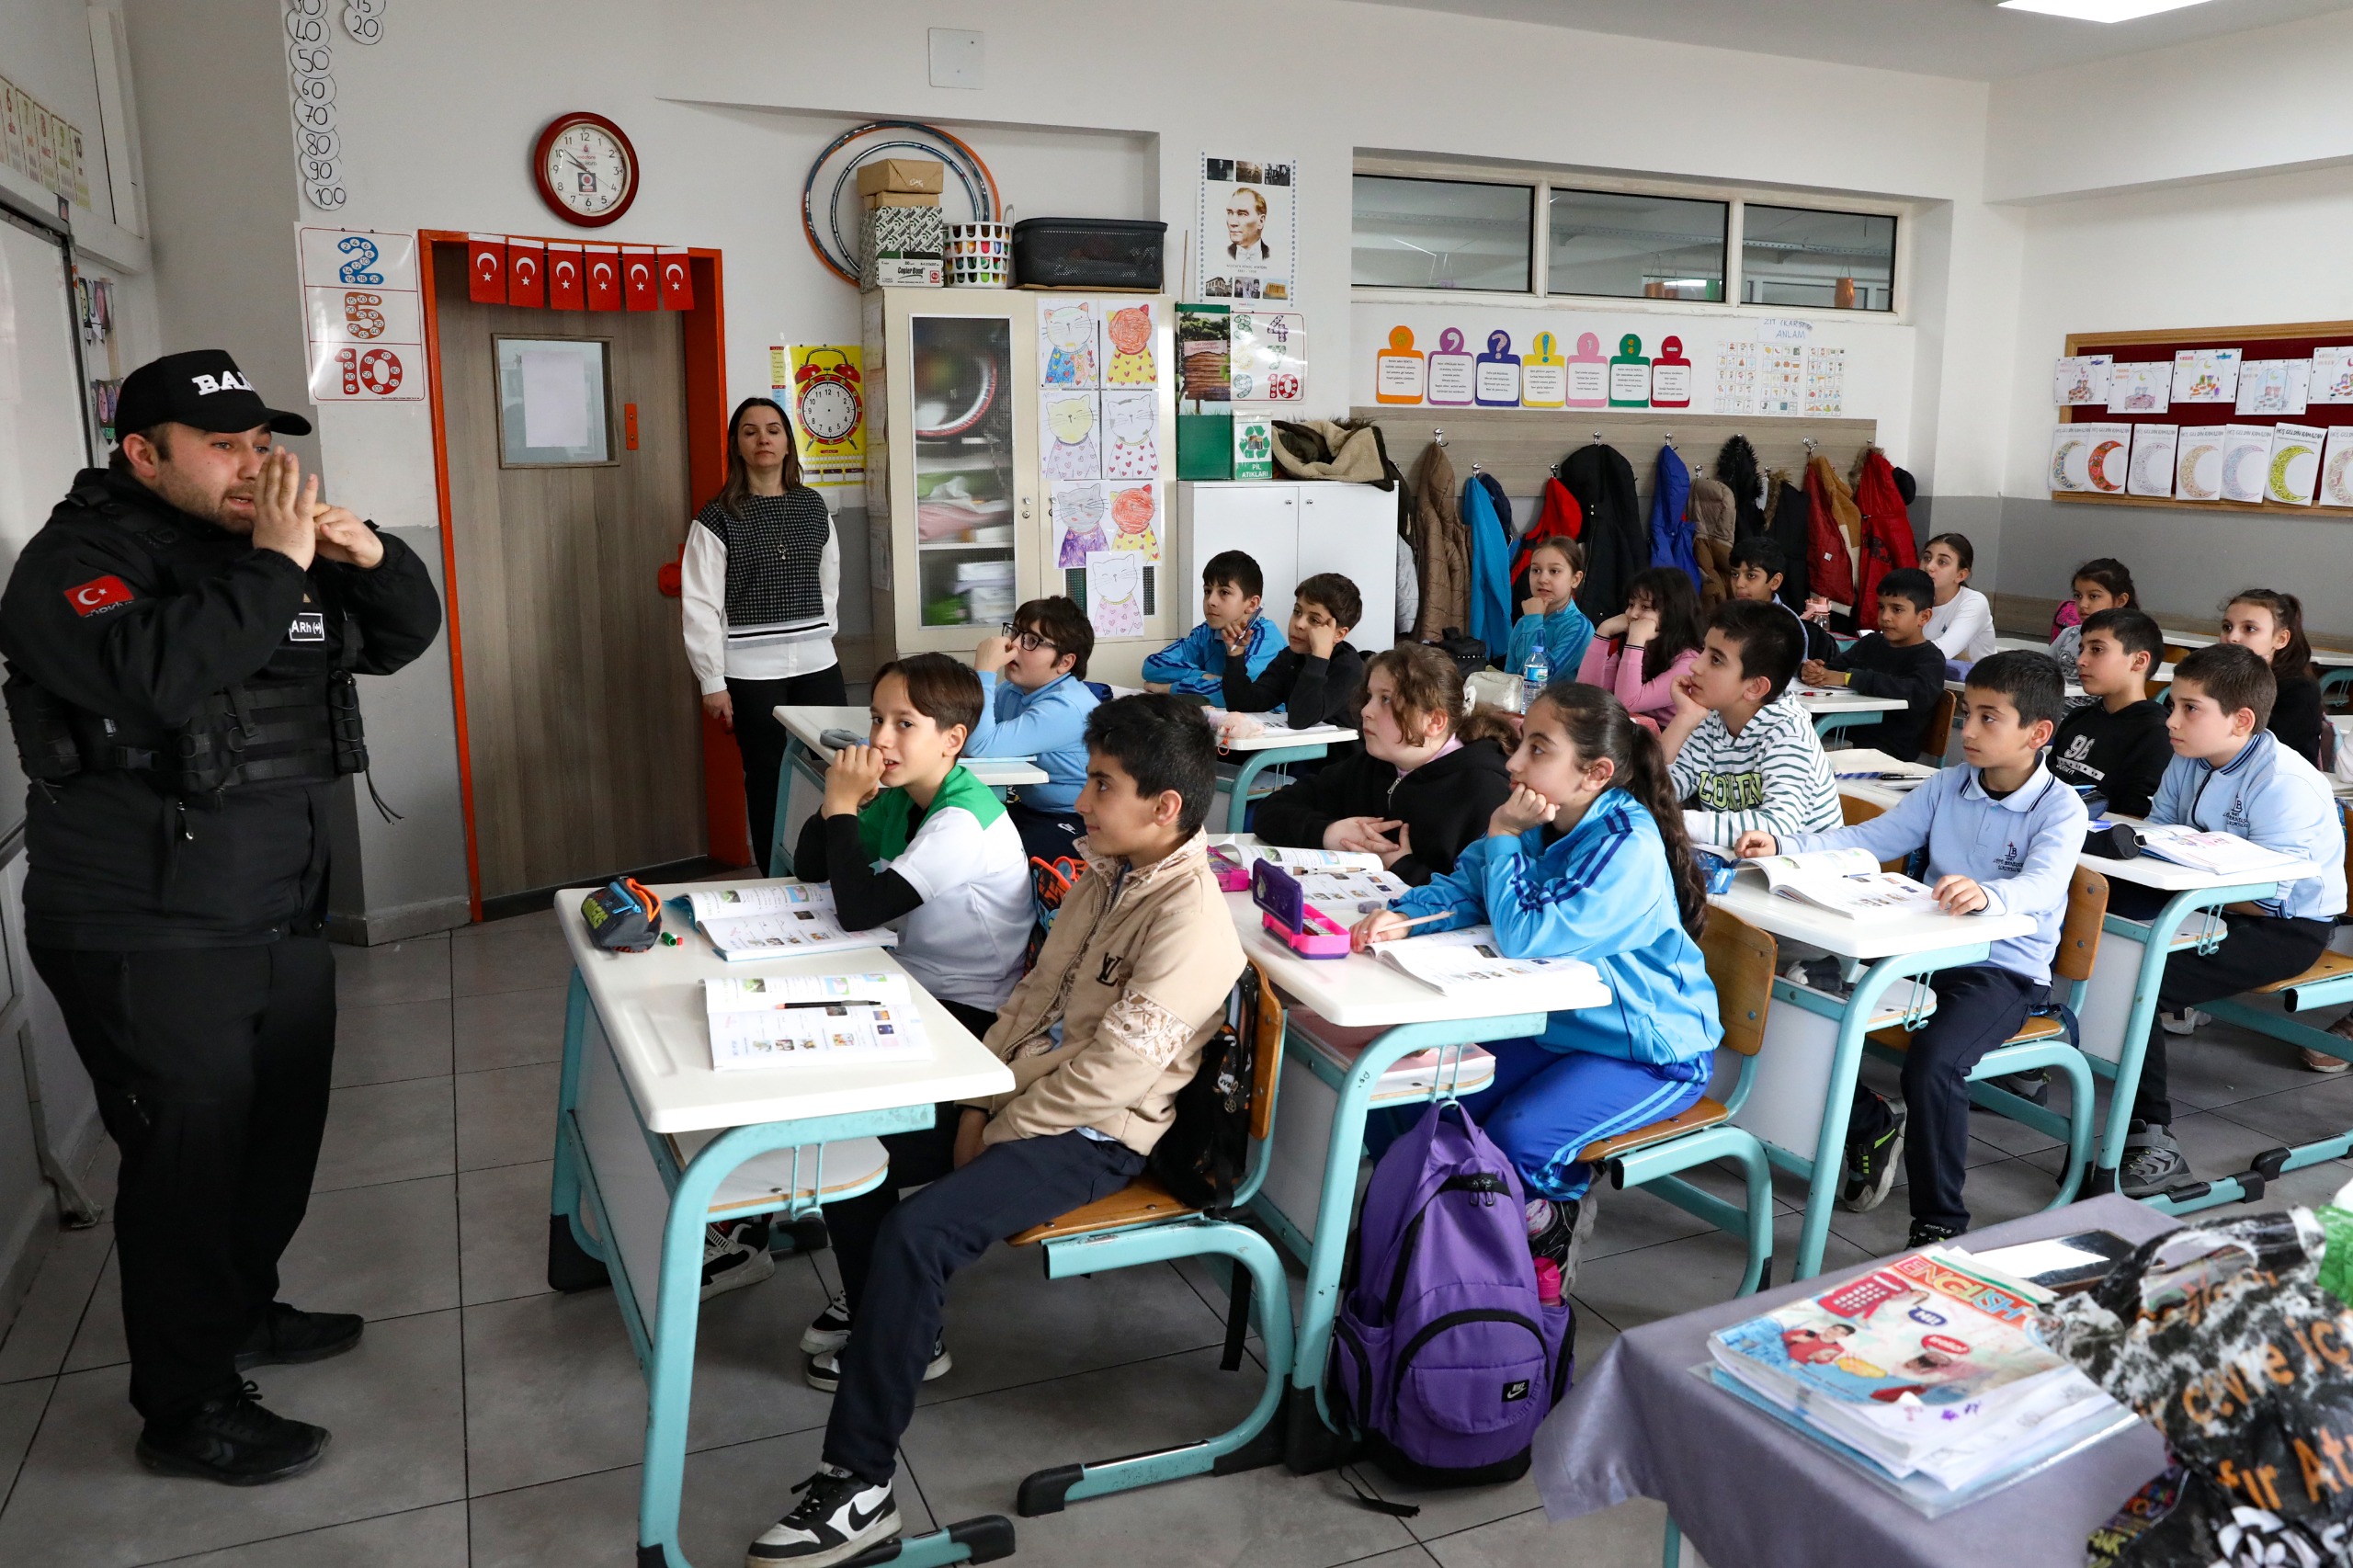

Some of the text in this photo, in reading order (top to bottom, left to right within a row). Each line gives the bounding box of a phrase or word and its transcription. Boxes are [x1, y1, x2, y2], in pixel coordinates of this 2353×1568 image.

[296, 19, 321, 41] 40
[353, 15, 379, 37] 20
[298, 49, 329, 73] 50
[302, 79, 324, 99] 60
[304, 104, 327, 125] 70
[306, 133, 331, 155] 80
[564, 137, 572, 145] 11
[581, 132, 590, 142] 12
[598, 138, 602, 146] 1
[555, 149, 563, 158] 10
[609, 150, 615, 158] 2
[310, 162, 332, 180] 90
[553, 165, 559, 174] 9
[614, 166, 620, 176] 3
[558, 182, 563, 191] 8
[611, 184, 617, 192] 4
[316, 187, 346, 206] 100
[585, 198, 592, 207] 6
[601, 196, 607, 204] 5
[338, 237, 384, 285] 2
[898, 267, 912, 275] Copier
[345, 292, 385, 339] 5
[1267, 315, 1289, 342] 4
[1776, 330, 1805, 339] ANLAM
[335, 348, 403, 395] 10
[1267, 374, 1298, 398] 10
[1895, 1256, 2026, 1321] ENGLISH
[1512, 1382, 1525, 1392] NIKE
